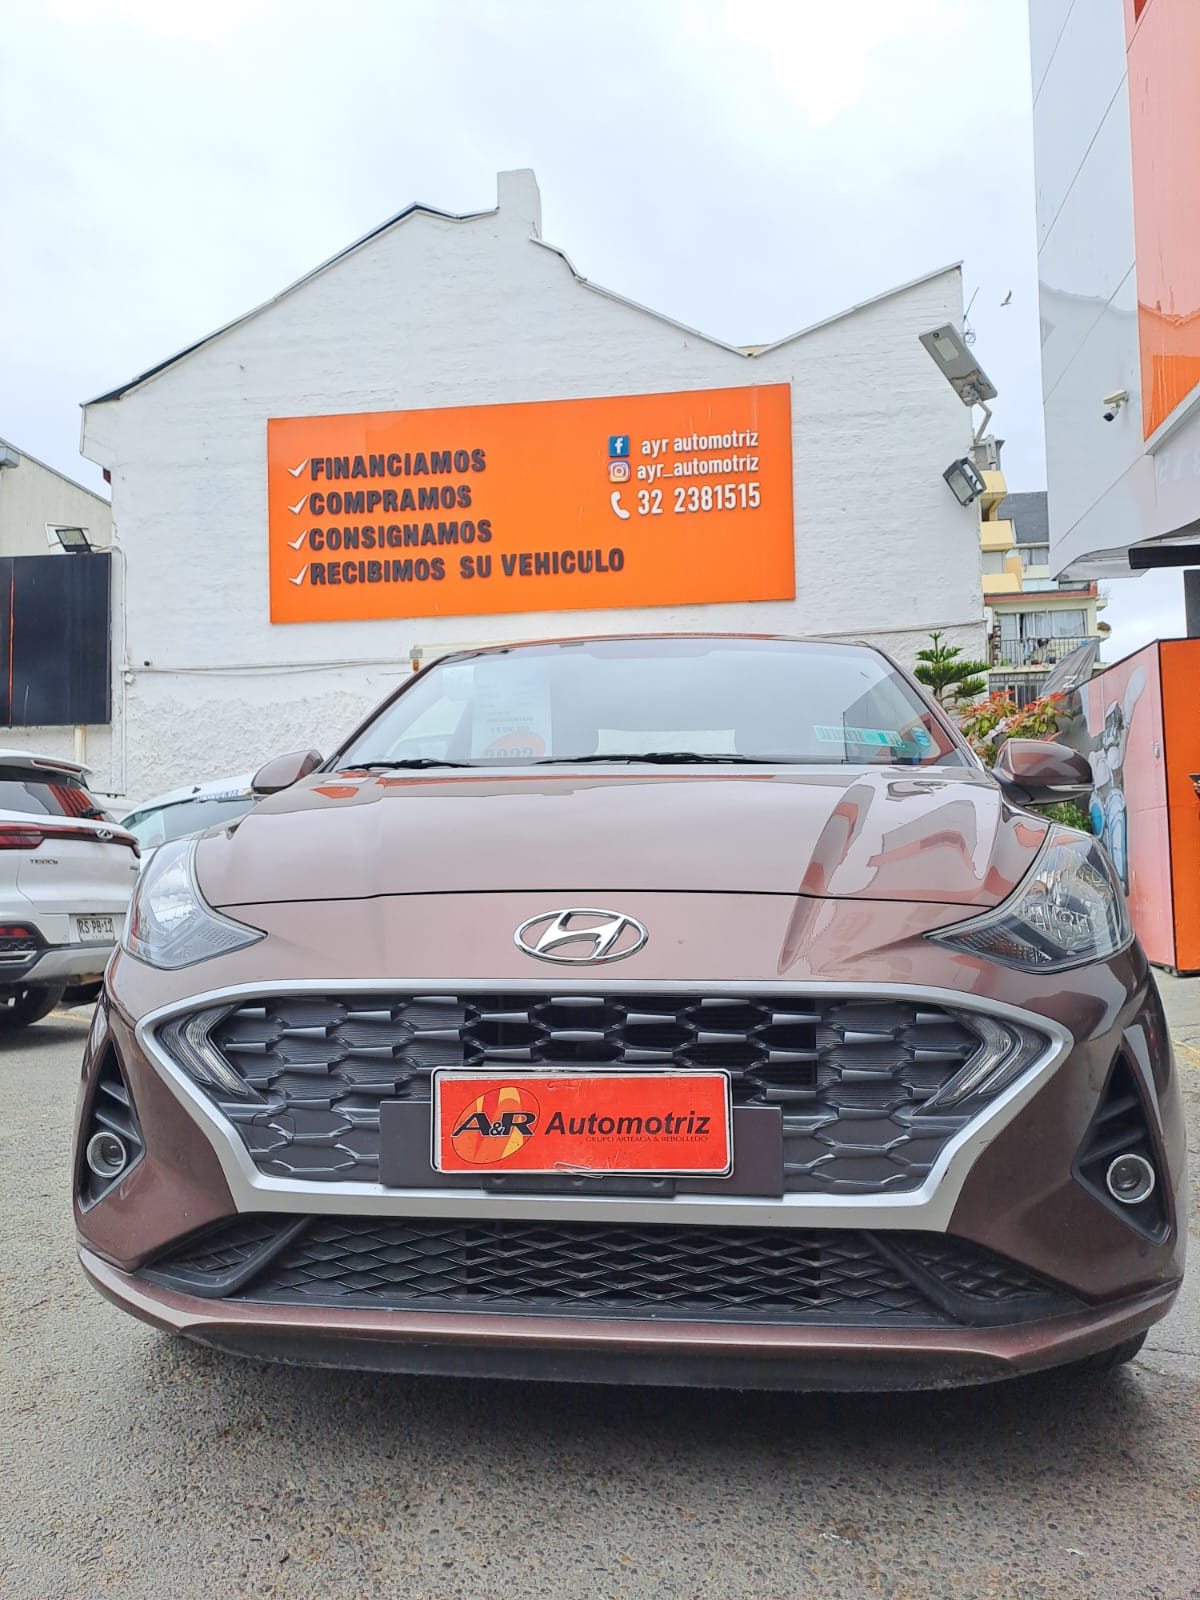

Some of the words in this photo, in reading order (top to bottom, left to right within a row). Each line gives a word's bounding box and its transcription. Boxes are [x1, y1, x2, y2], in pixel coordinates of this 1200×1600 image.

[641, 437, 669, 459] ayr
[673, 430, 759, 452] automotriz
[310, 448, 486, 481] FINANCIAMOS
[637, 454, 759, 483] ayr_automotriz
[309, 484, 472, 515] COMPRAMOS
[637, 489, 664, 515] 32
[673, 482, 761, 513] 2381515
[308, 519, 492, 551] CONSIGNAMOS
[310, 556, 446, 586] RECIBIMOS
[459, 555, 492, 579] SU
[500, 547, 625, 577] VEHICULO
[451, 1111, 537, 1138] A&R
[544, 1110, 711, 1136] Automotriz
[585, 1136, 614, 1144] GRUPO
